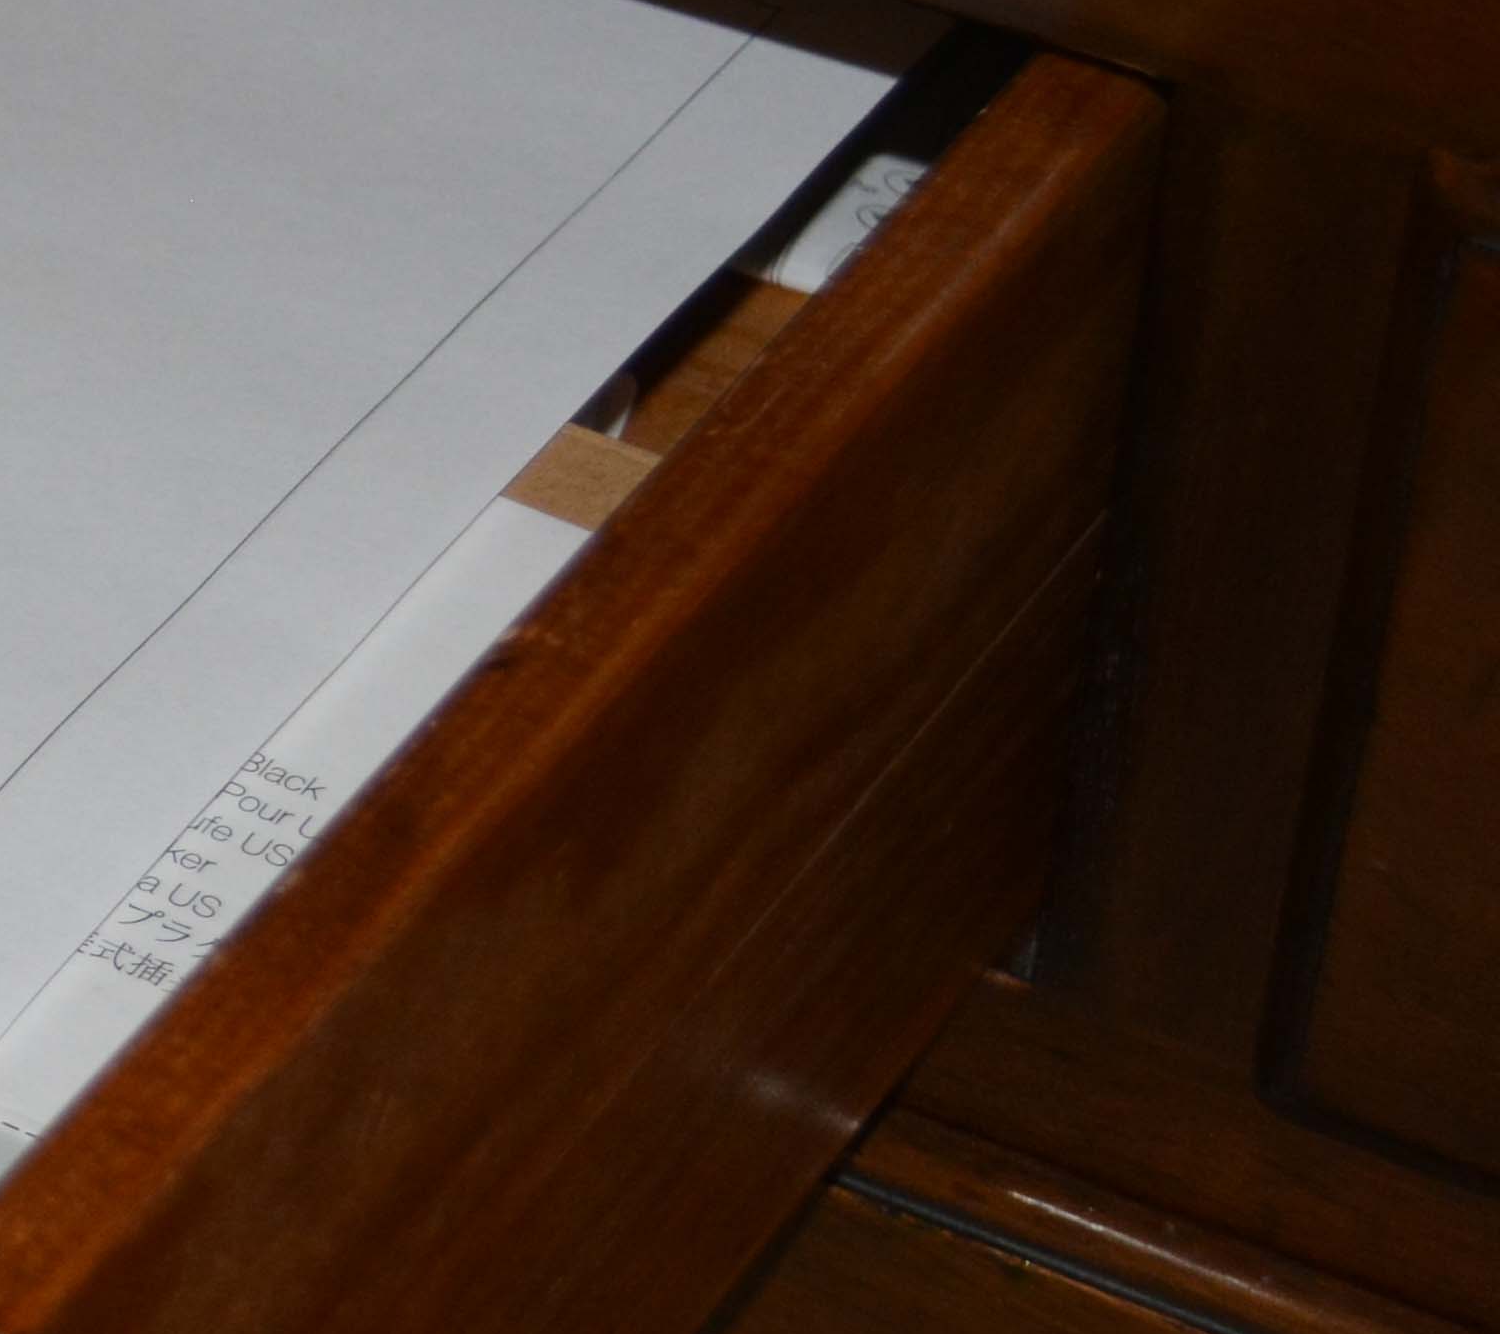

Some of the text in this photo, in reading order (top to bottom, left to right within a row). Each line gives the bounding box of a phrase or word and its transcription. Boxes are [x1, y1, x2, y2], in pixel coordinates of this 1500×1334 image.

[240, 751, 328, 801] Black
[220, 781, 295, 825] Pour
[240, 831, 296, 867] US
[136, 875, 223, 918] a US
